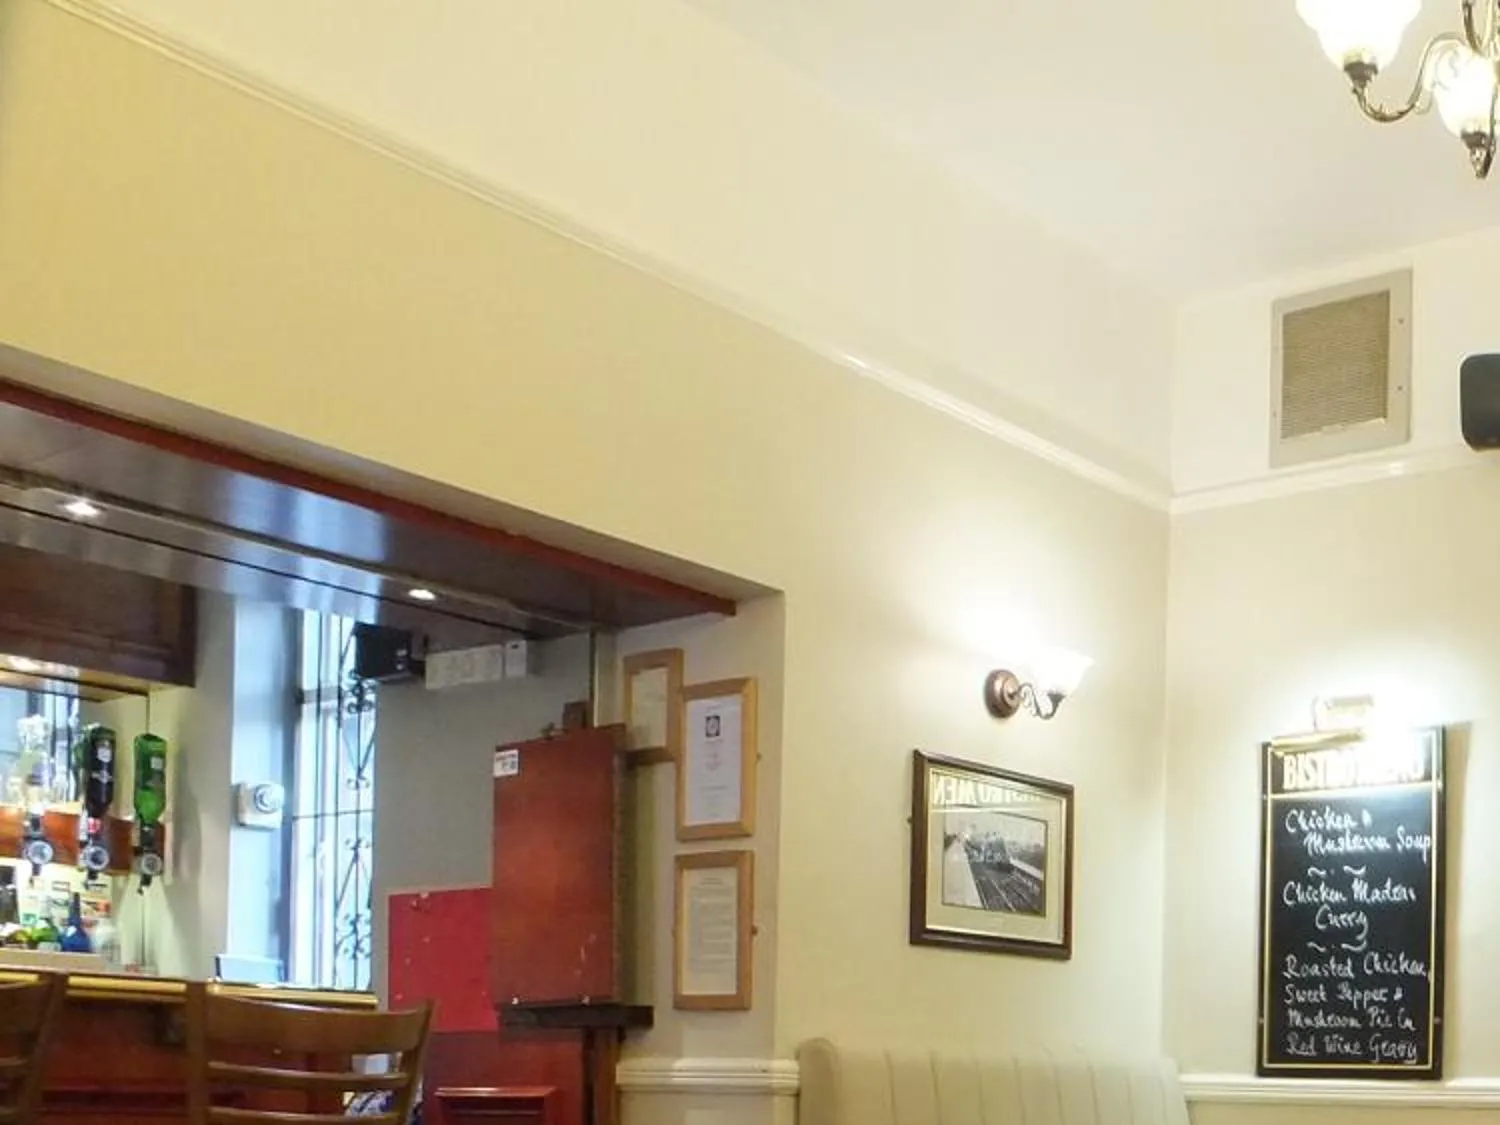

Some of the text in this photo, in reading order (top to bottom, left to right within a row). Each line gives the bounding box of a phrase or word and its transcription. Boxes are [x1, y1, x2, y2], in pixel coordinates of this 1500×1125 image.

[1285, 805, 1358, 833] Chicken
[1396, 825, 1432, 864] Soup
[1283, 880, 1348, 906] Chicken
[1315, 903, 1369, 940] Curry
[1283, 953, 1355, 979] Roasted
[1284, 983, 1327, 1004] Sweet
[1336, 981, 1389, 1010] Pepper
[1367, 1005, 1393, 1028] Pie
[1286, 1031, 1417, 1064] Red Wine Gravy
